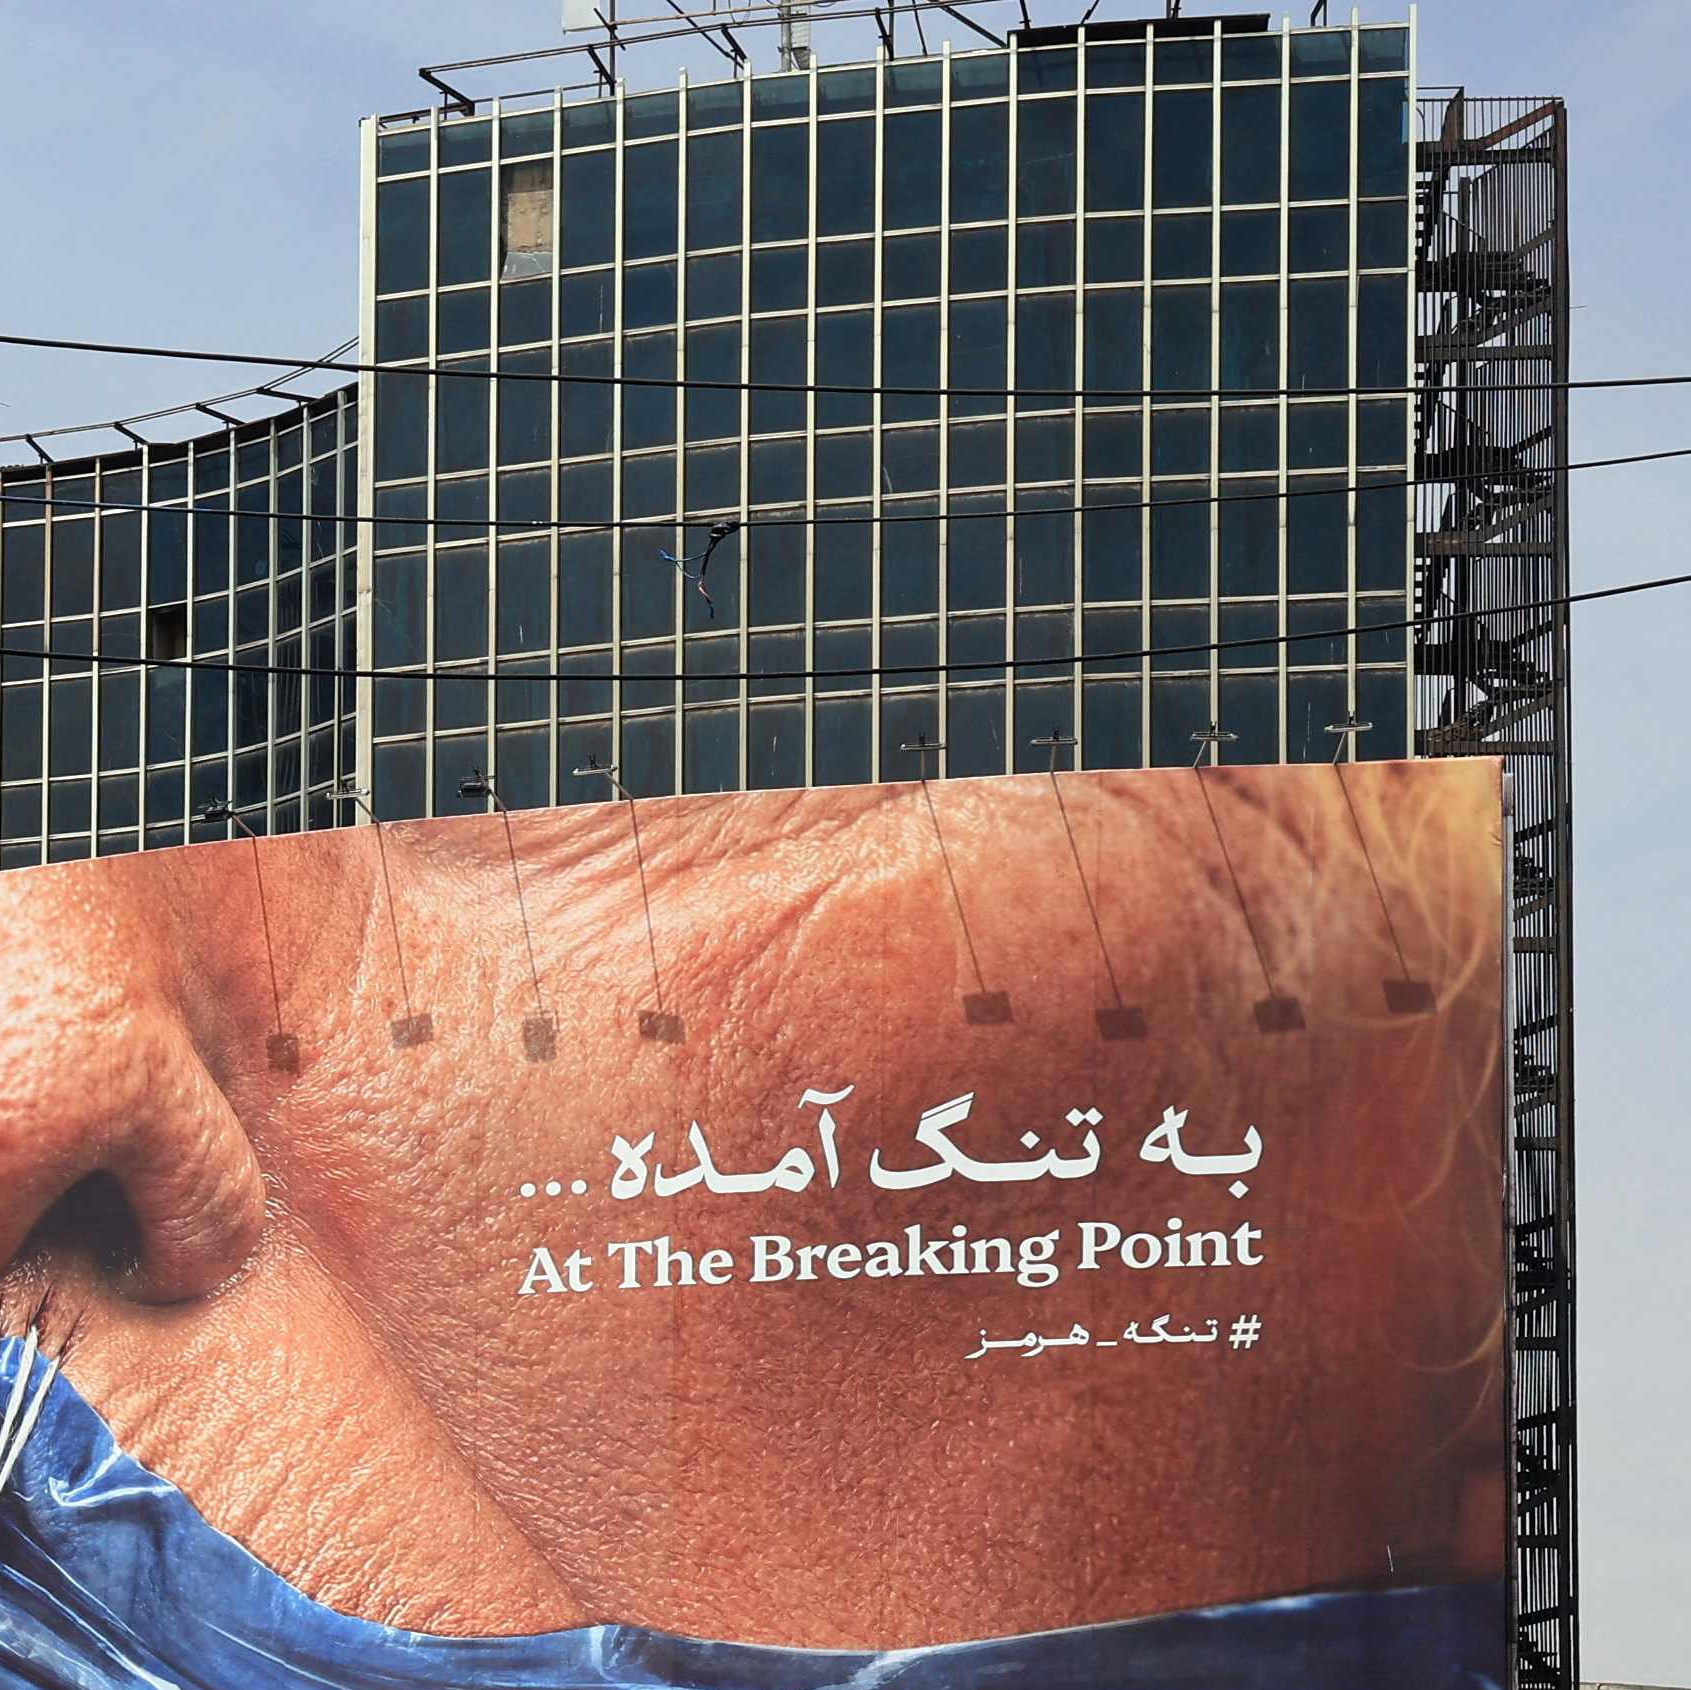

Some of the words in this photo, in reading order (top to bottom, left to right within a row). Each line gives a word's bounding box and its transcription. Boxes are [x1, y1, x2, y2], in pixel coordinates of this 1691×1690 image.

[610, 1084, 855, 1199] آمده
[869, 1091, 1103, 1190] تنگ
[1139, 1105, 1263, 1199] به
[517, 1247, 594, 1295] At
[607, 1235, 734, 1290] The
[749, 1224, 1060, 1288] Breaking
[1076, 1217, 1265, 1270] Point
